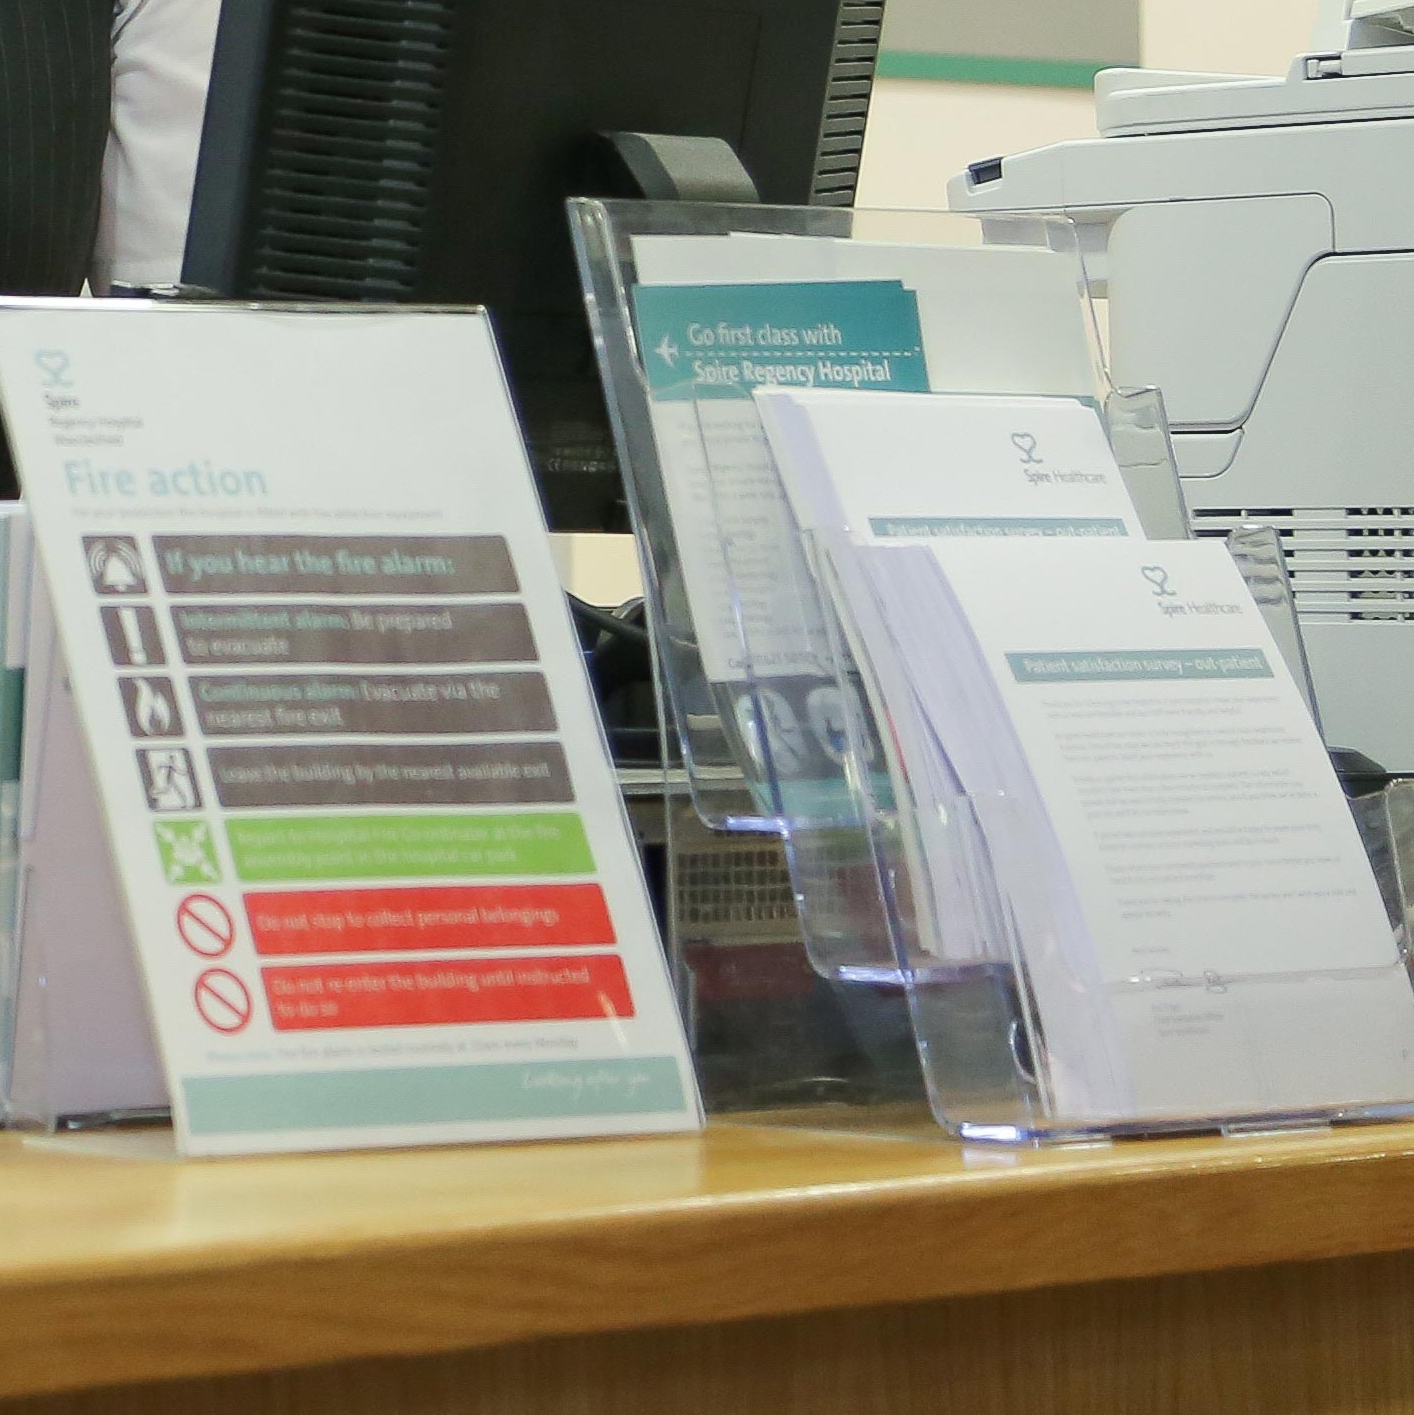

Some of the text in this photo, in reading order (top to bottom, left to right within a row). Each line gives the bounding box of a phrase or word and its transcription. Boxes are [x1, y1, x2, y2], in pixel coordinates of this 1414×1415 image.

[689, 322, 843, 346] Go first class with
[694, 360, 892, 388] Spire Regency Hospital
[63, 457, 270, 498] Fire action
[1024, 468, 1107, 485] Spire Healthcare
[165, 548, 455, 581] If you hear the fire alarm:
[1157, 600, 1243, 617] Spire Healthcare
[376, 611, 453, 634] prepared
[211, 638, 289, 656] evacuate
[1023, 657, 1069, 674] Patient
[1071, 656, 1142, 673] satisfaction
[1144, 658, 1183, 676] survey
[469, 680, 501, 700] the
[312, 912, 344, 933] stop
[417, 907, 478, 930] personal
[480, 906, 560, 928] belongings
